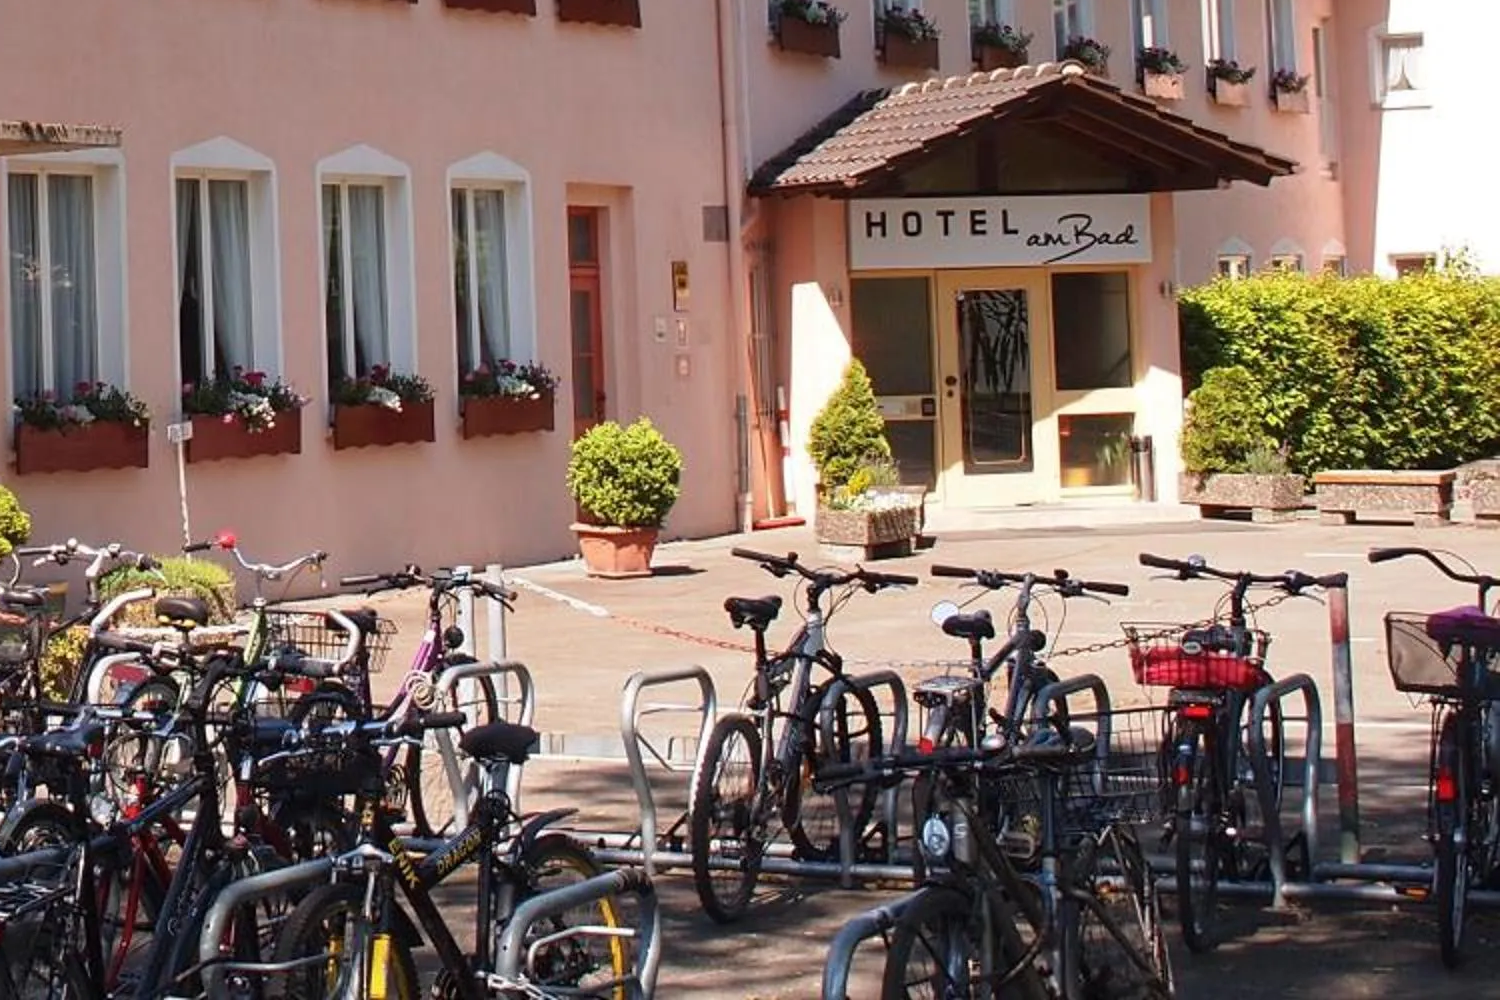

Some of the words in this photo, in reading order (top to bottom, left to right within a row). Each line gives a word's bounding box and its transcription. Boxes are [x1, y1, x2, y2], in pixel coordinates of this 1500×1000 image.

[864, 208, 1019, 239] HOTEL
[1026, 231, 1071, 247] am
[1042, 212, 1139, 265] Bad
